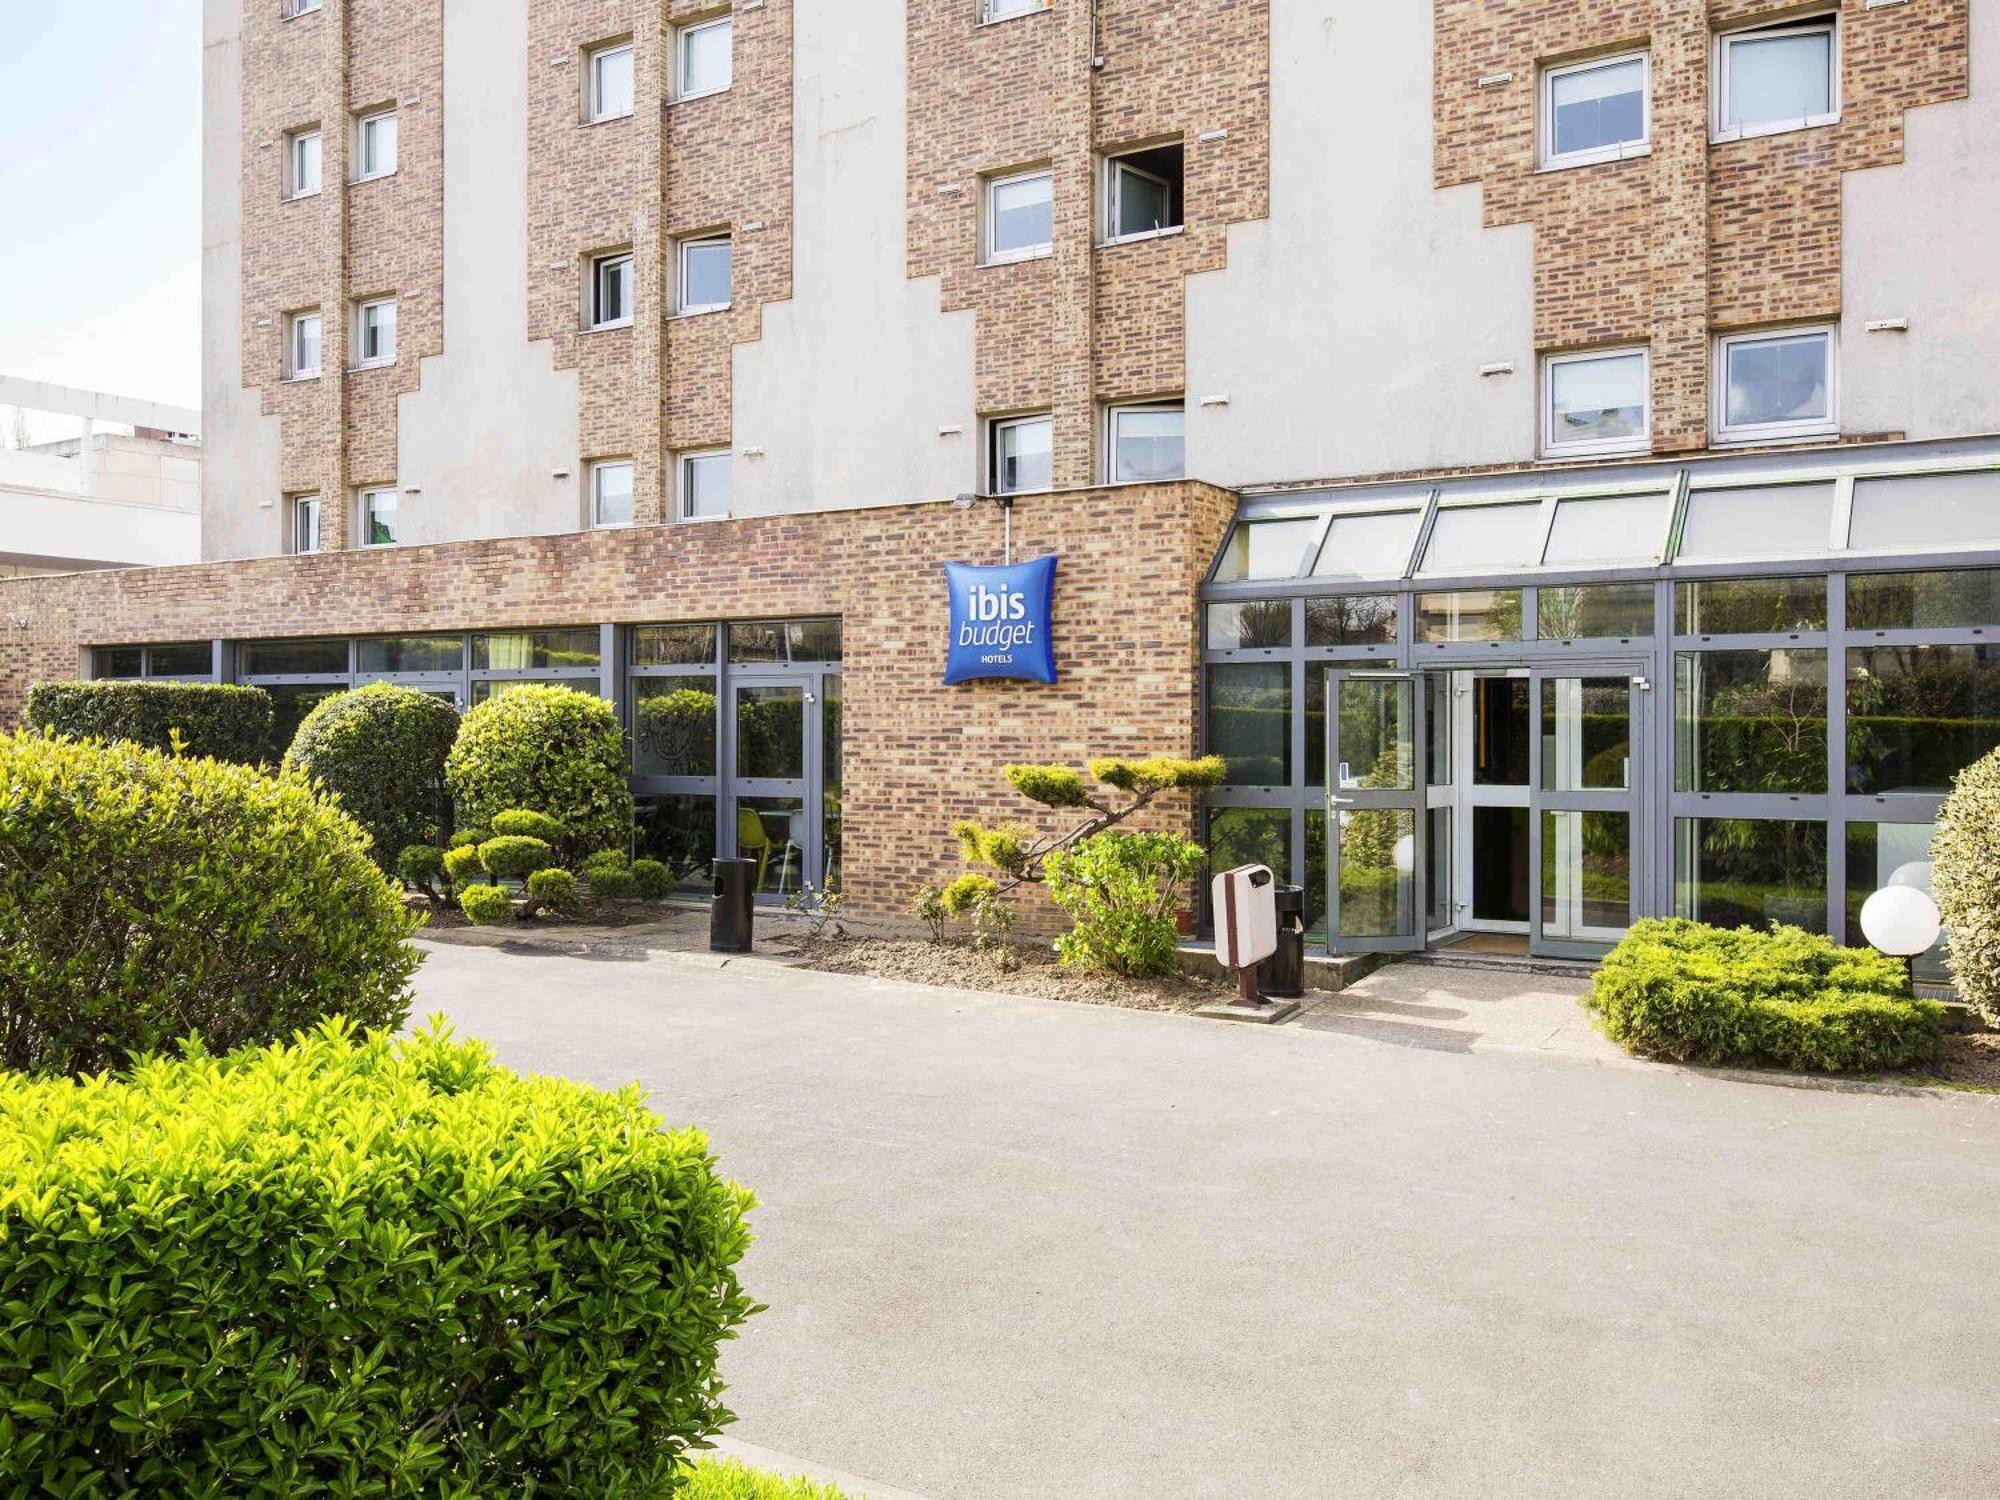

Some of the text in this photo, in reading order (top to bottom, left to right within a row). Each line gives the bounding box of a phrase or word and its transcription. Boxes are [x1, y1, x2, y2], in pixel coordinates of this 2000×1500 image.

[969, 584, 1025, 620] ibis
[959, 620, 1035, 651] budget
[981, 654, 1013, 664] HOTELS
